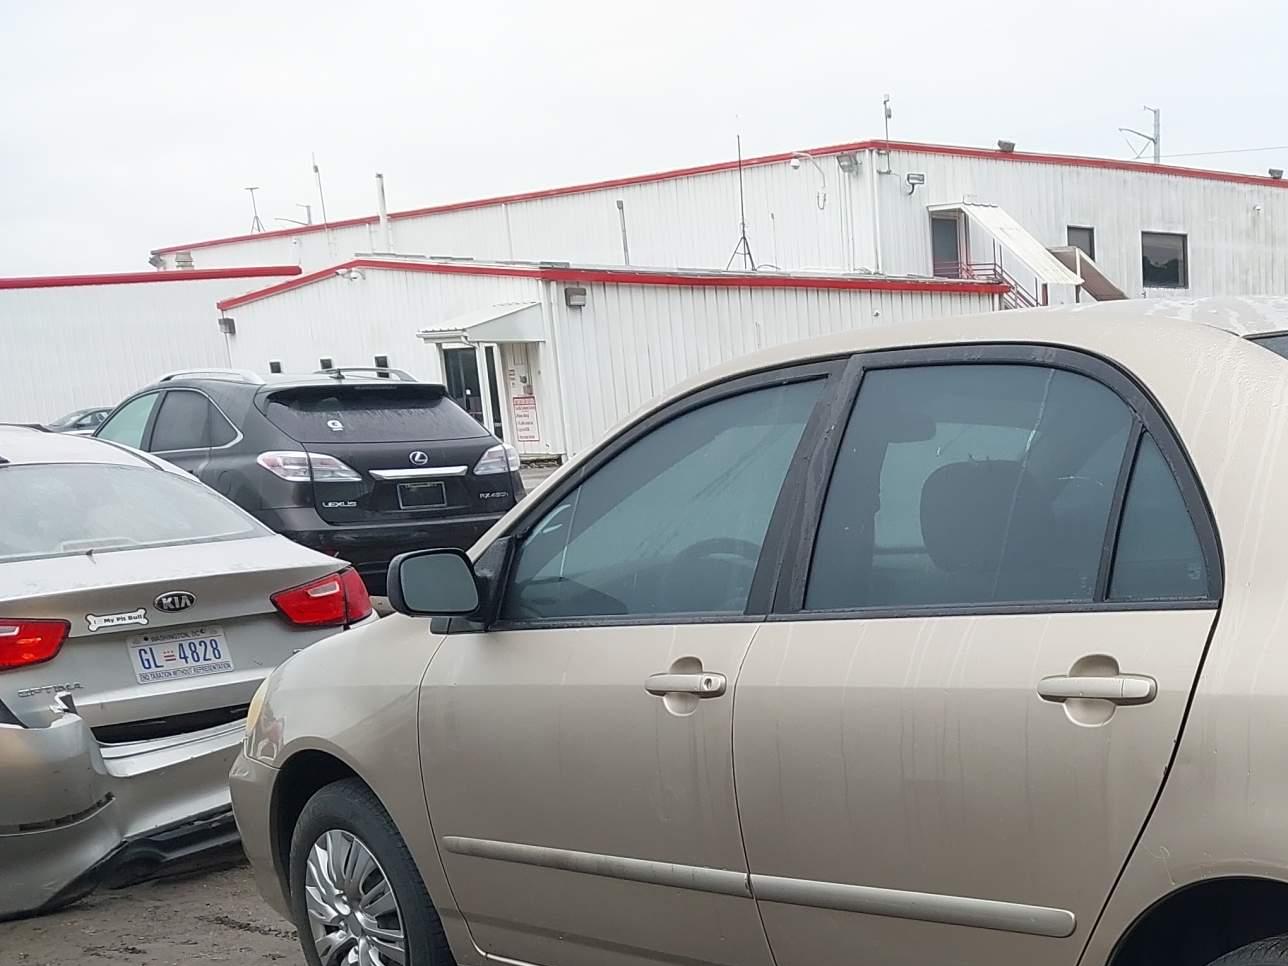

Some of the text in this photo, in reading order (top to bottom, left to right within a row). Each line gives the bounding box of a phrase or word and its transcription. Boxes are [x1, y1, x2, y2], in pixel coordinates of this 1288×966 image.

[162, 595, 191, 610] KIA
[128, 613, 142, 621] Bull
[138, 638, 222, 670] GL 4828
